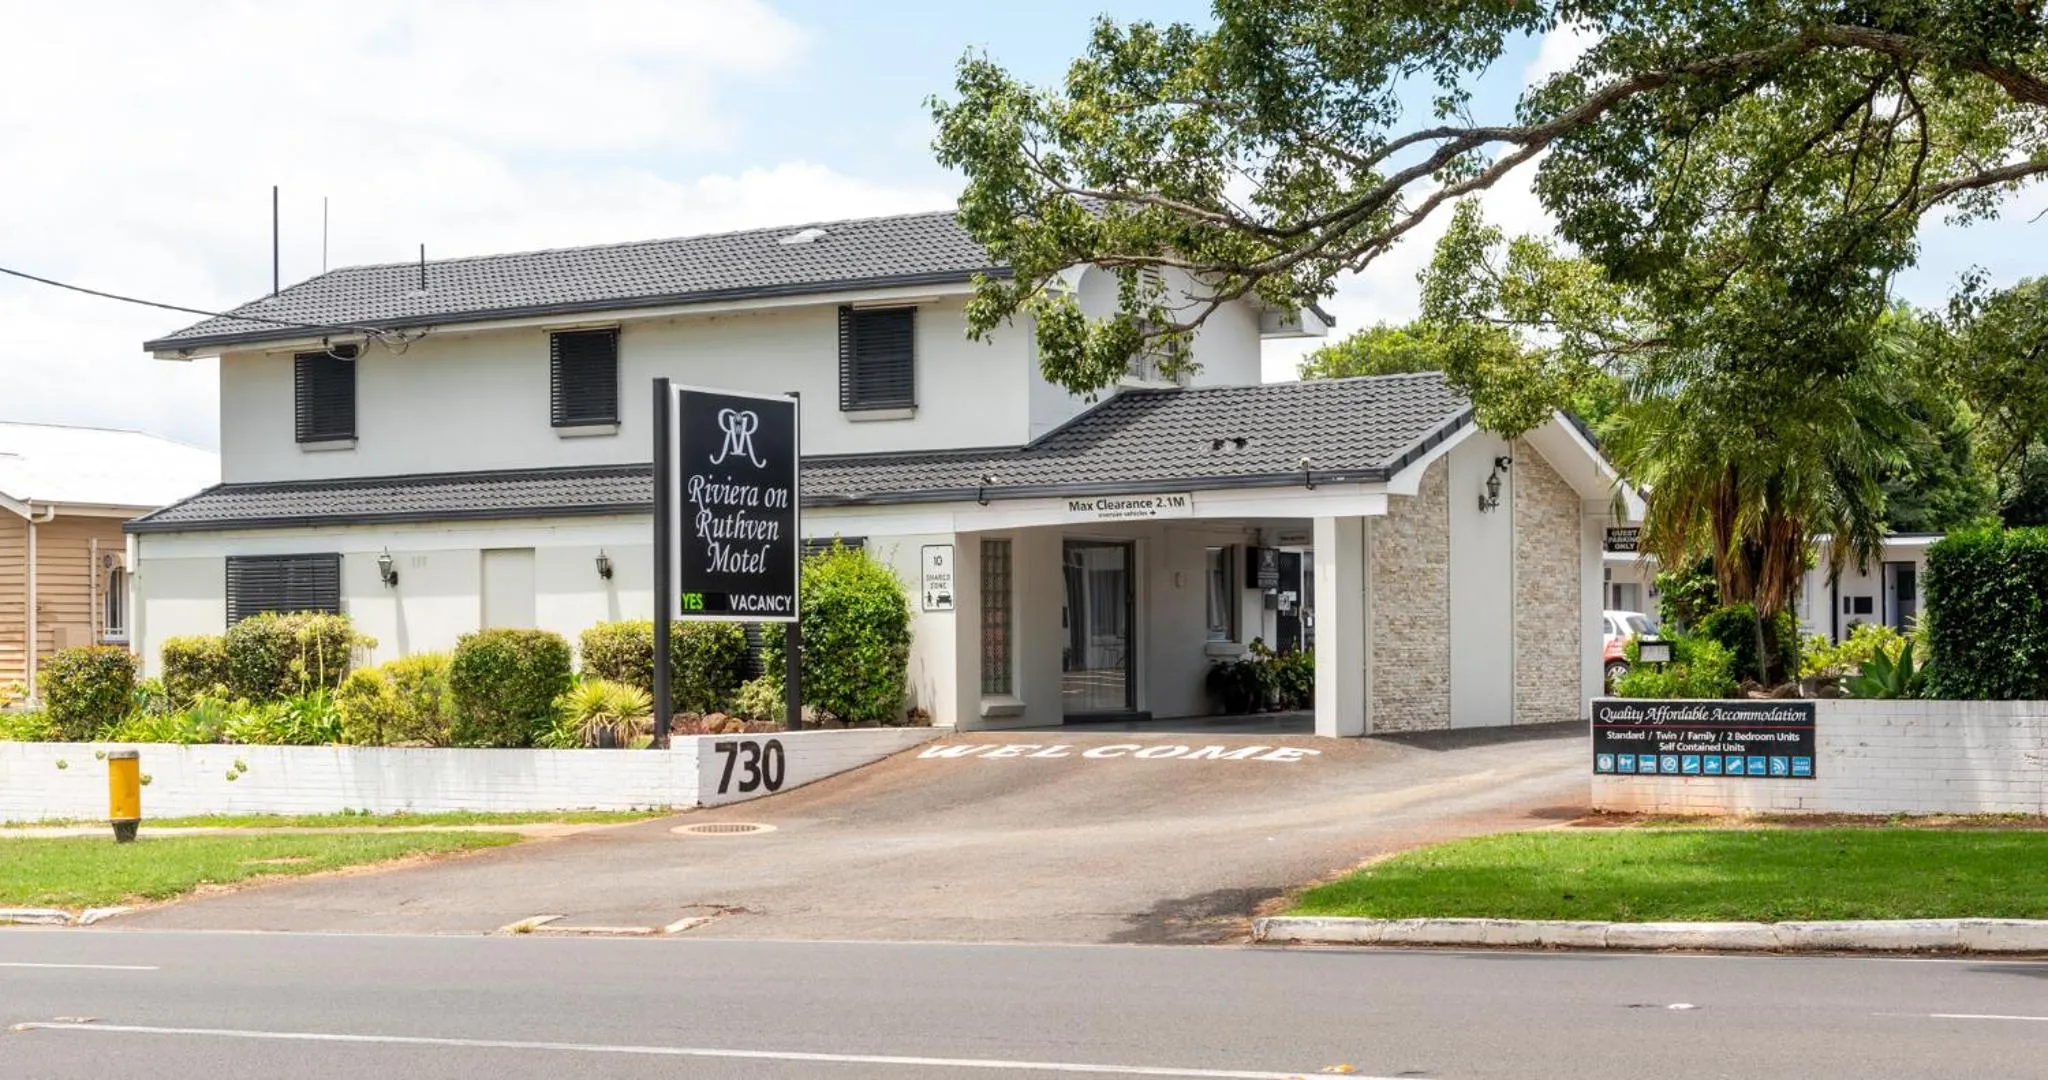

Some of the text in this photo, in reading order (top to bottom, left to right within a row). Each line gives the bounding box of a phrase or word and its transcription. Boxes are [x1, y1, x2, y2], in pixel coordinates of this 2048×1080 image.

[688, 474, 789, 511] Riviera on
[1068, 496, 1185, 512] Max Clearance 2.1M
[695, 507, 780, 543] Ruthven
[706, 541, 771, 574] Motel
[933, 555, 943, 566] 10
[681, 592, 792, 611] YES VACANCY
[1600, 705, 1807, 724] Quality Affordable Accommodation
[1606, 731, 1646, 740] Standard
[1656, 731, 1677, 740] Twin
[1687, 731, 1716, 743] Family
[1726, 732, 1733, 741] 2
[1735, 732, 1775, 741] Bedroom
[1777, 732, 1800, 742] Units
[916, 743, 1322, 763] WELCOME
[1659, 742, 1745, 752] Self Contained Units
[715, 738, 785, 795] 730
